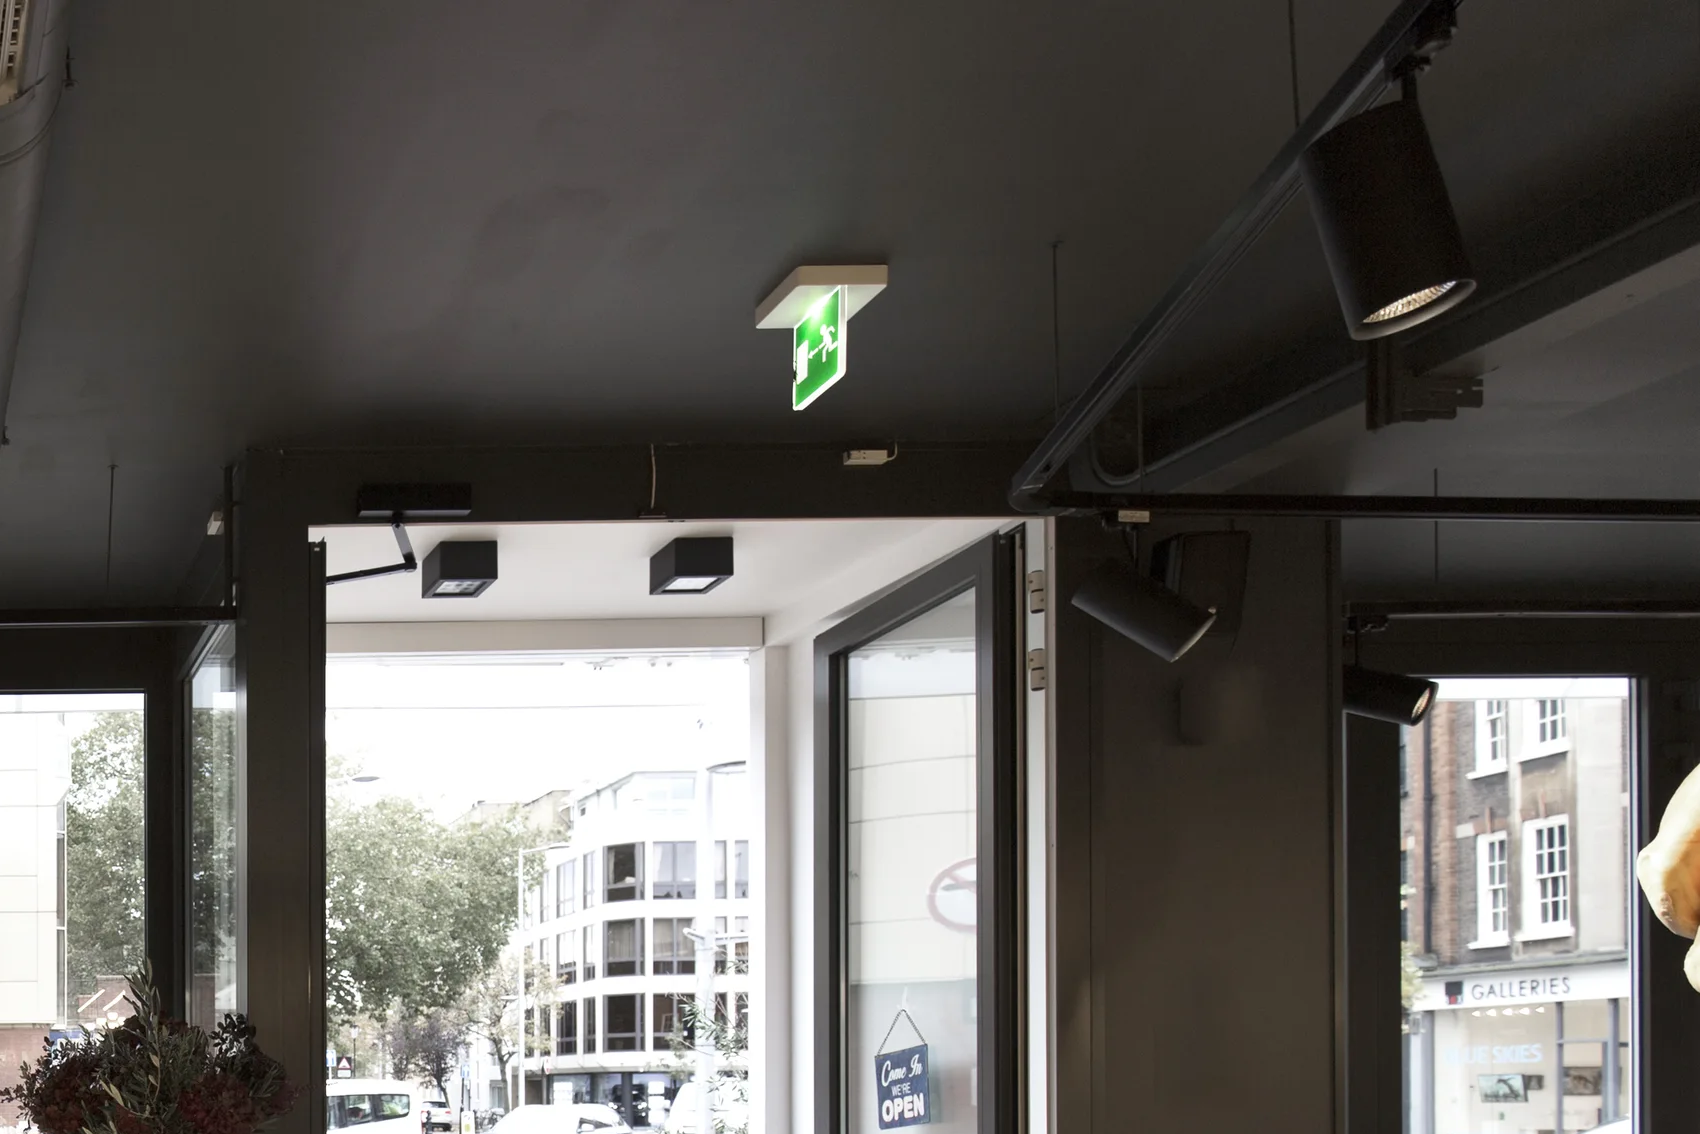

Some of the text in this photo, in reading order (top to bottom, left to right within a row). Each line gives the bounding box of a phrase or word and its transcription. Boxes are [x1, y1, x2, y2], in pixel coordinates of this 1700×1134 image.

[1471, 976, 1571, 1000] GALLERIES
[1492, 1043, 1543, 1063] SKIES
[881, 1054, 923, 1087] Come In
[891, 1082, 911, 1097] WE'RE
[882, 1092, 925, 1122] OPEN
